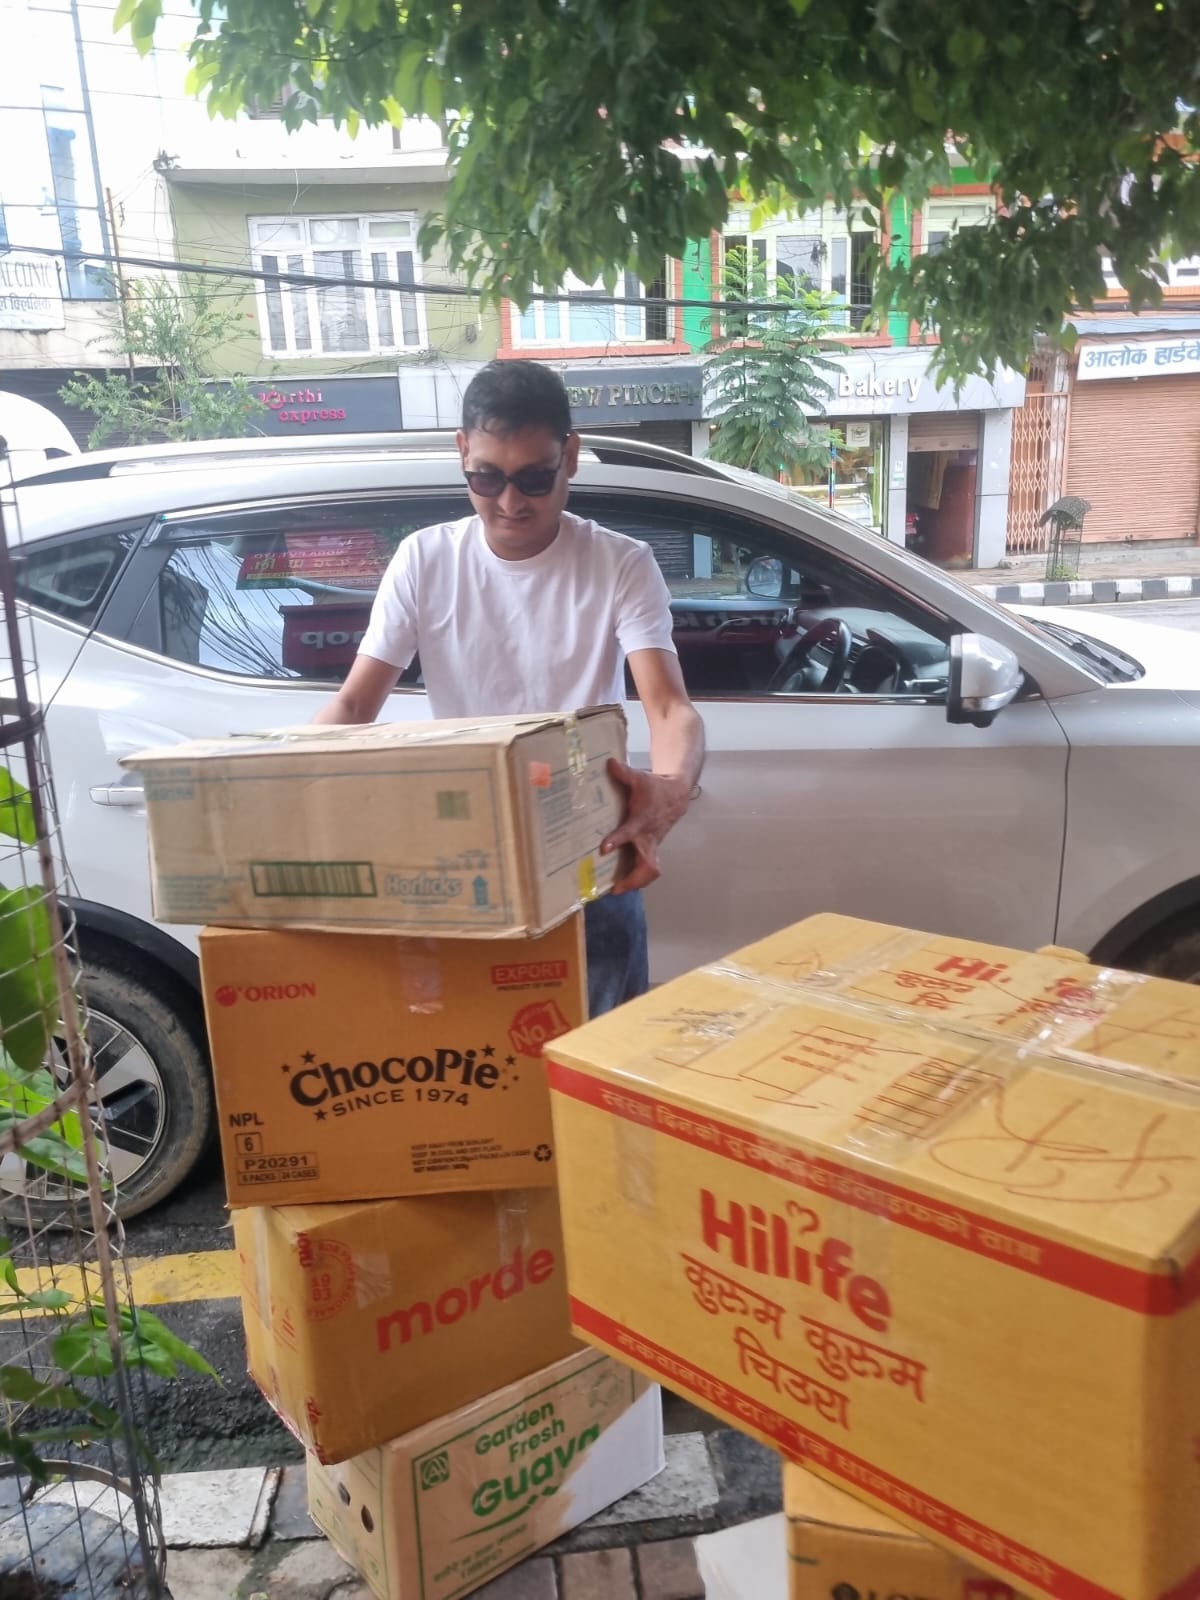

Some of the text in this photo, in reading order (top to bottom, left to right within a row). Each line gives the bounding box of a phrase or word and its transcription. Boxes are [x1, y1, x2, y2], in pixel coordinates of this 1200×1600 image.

[15, 261, 52, 288] CLINIC
[1084, 345, 1148, 368] आलोक
[565, 385, 602, 407] EW
[838, 372, 922, 403] Bakery
[279, 408, 346, 425] express
[385, 872, 464, 897] Horlicks
[495, 963, 562, 981] EXPORT
[245, 982, 316, 1002] ORION
[289, 1048, 499, 1107] ChocoPie
[332, 1088, 469, 1117] SINCE 1974
[228, 1112, 265, 1128] NPL
[243, 1136, 254, 1152] 6
[244, 1156, 308, 1170] P20291
[699, 1188, 893, 1334] Hilife
[376, 1245, 555, 1354] morde
[733, 1326, 852, 1431] चिउरा
[474, 1402, 555, 1456] Garden
[508, 1418, 565, 1463] Fresh
